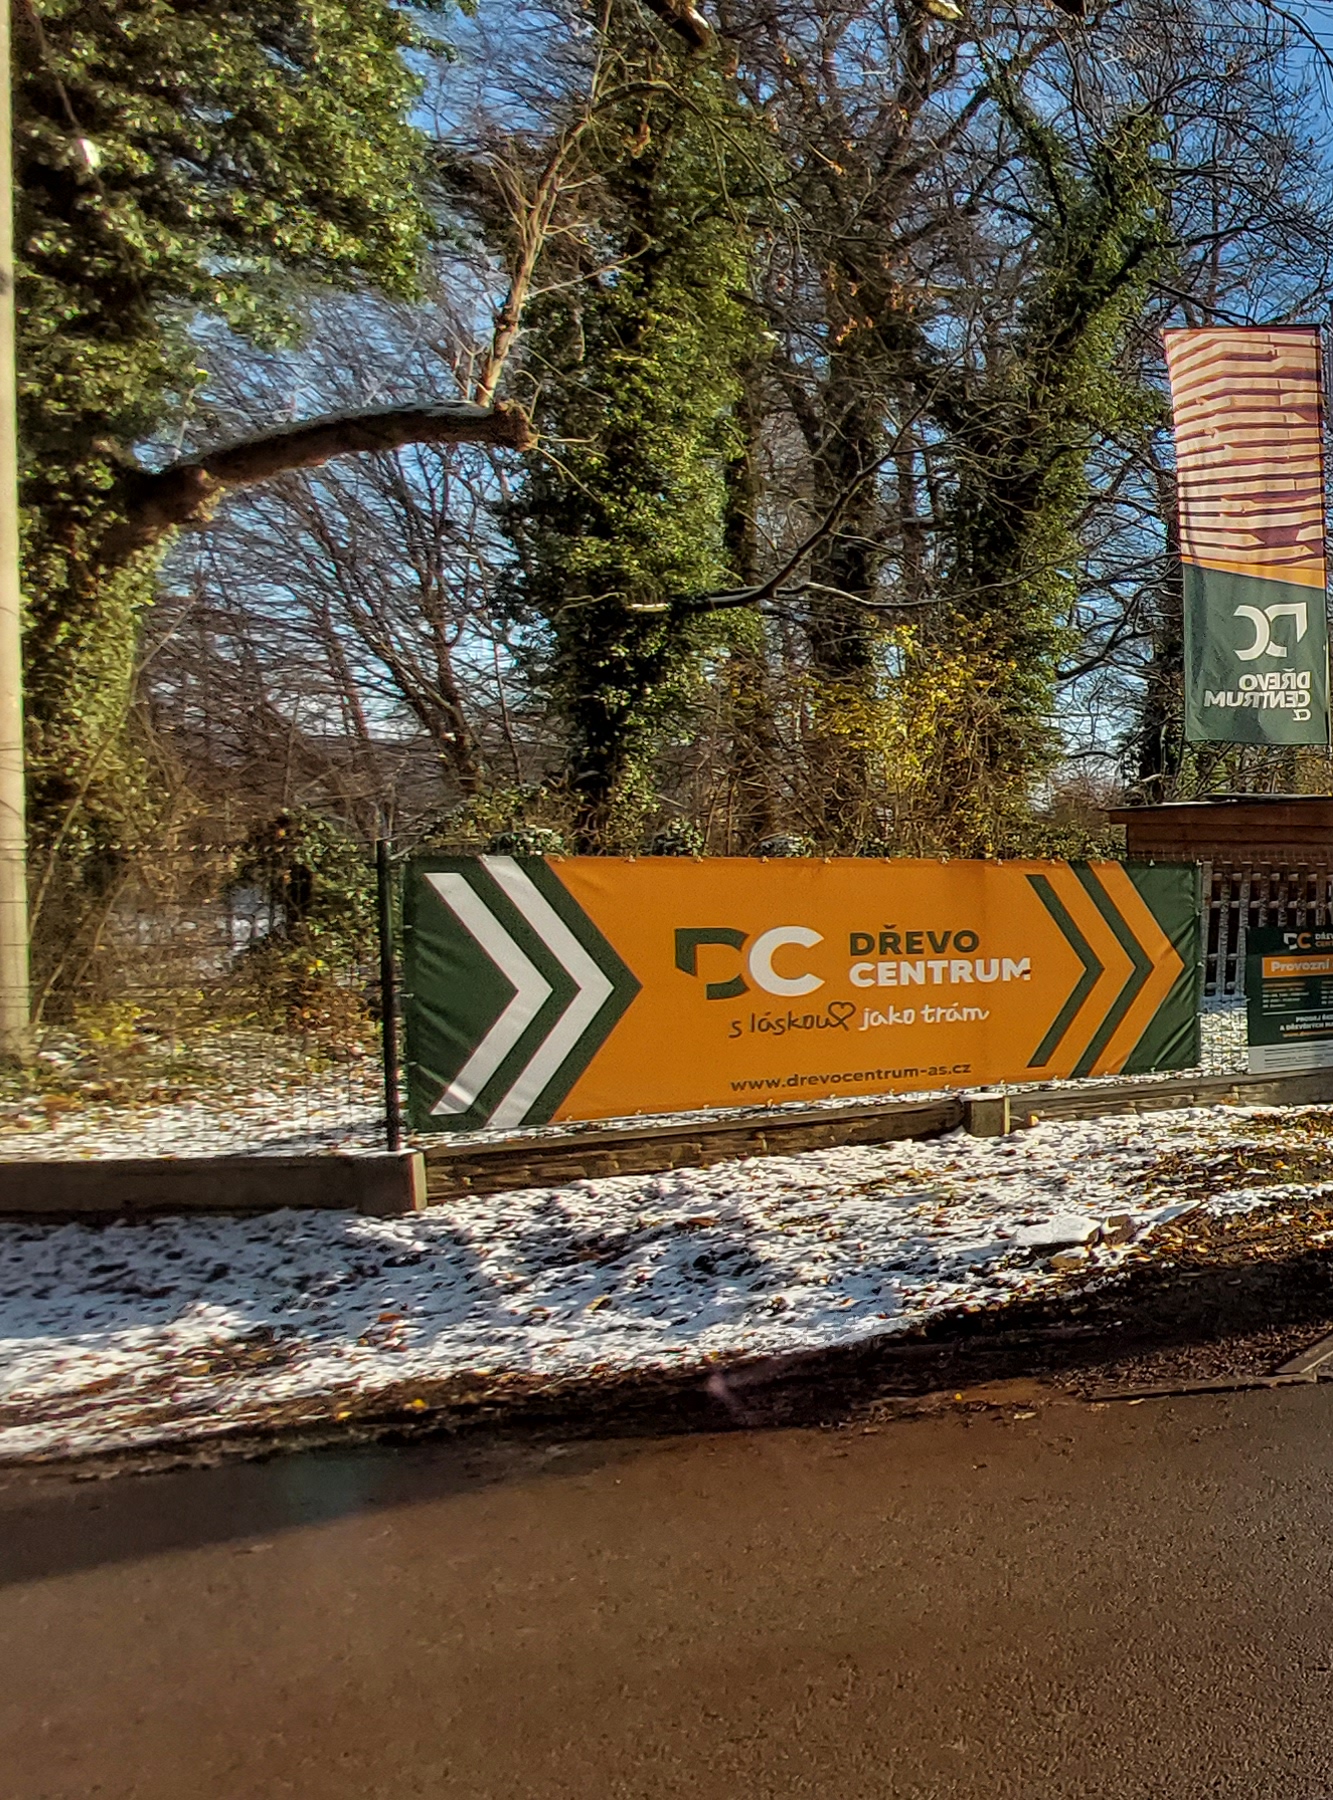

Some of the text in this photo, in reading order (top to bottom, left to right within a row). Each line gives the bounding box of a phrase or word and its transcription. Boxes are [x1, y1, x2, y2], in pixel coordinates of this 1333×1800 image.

[849, 924, 980, 957] DŘEVO
[675, 925, 825, 1001] DC
[849, 957, 1031, 988] CENTRUM
[1271, 959, 1329, 972] Provozní
[728, 1002, 990, 1038] s láskou jako trám
[731, 1063, 972, 1092] www.drevocentrum-as.cz
